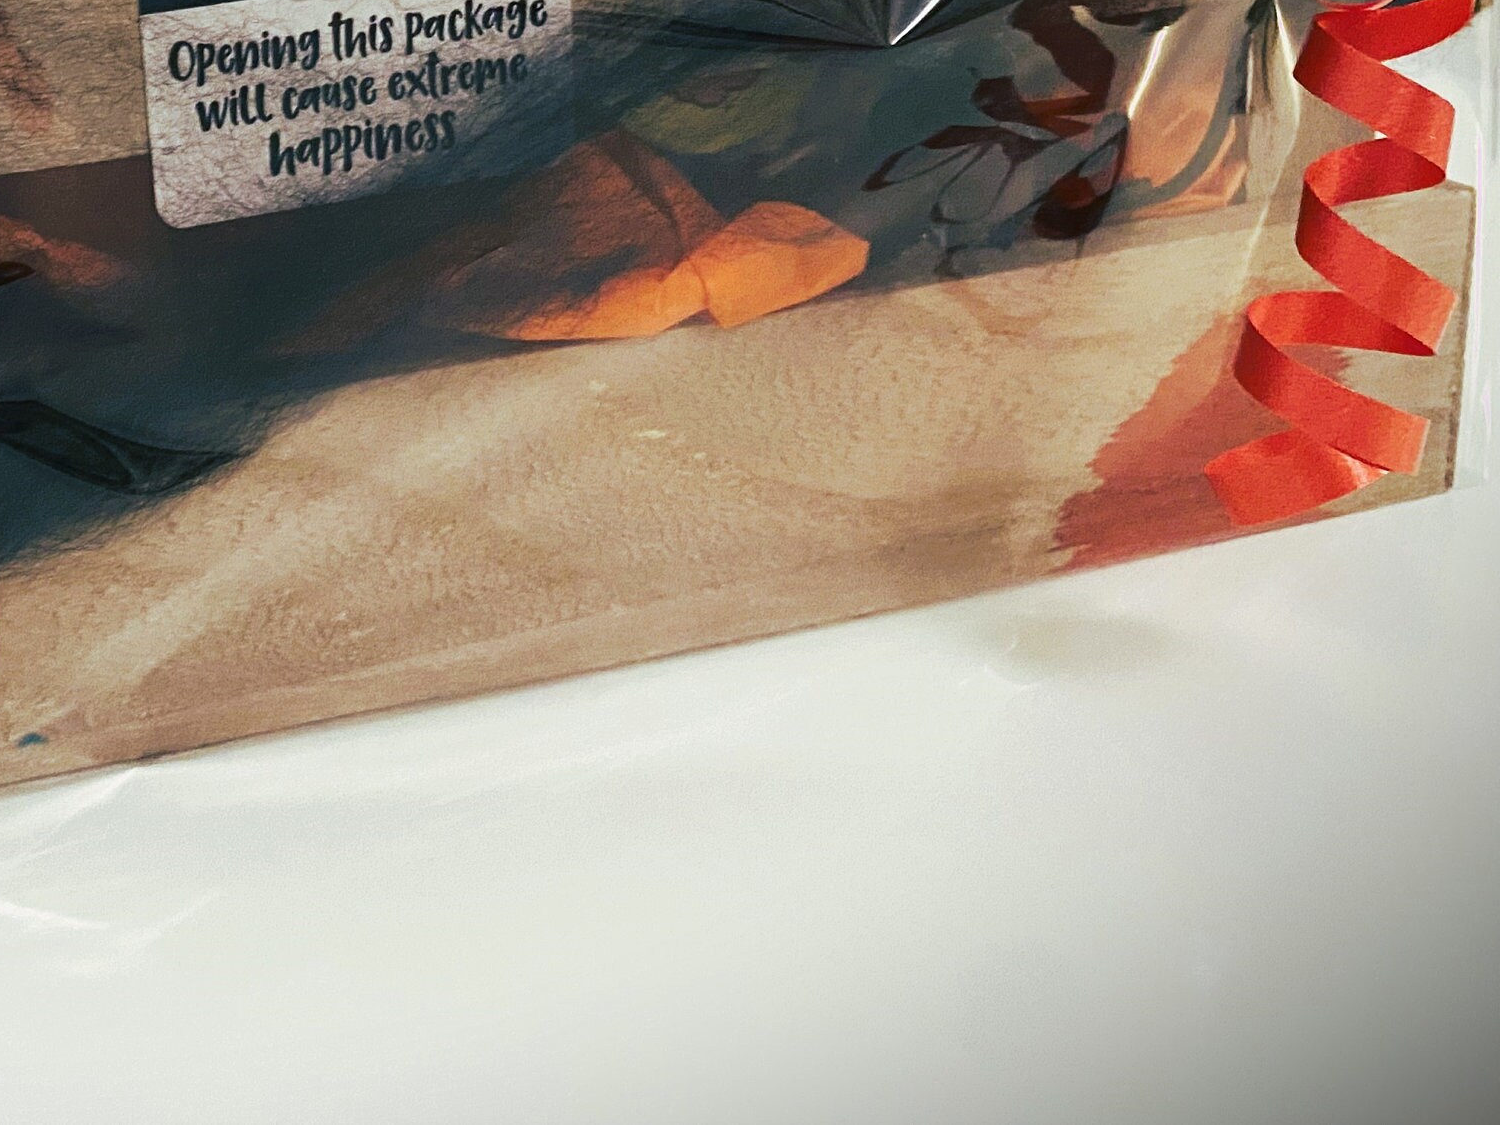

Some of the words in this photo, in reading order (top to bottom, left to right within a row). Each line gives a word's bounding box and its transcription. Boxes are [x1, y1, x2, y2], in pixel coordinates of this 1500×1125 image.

[168, 27, 320, 87] Opening
[328, 11, 394, 63] this
[195, 81, 272, 133] will
[281, 74, 378, 121] cause
[388, 49, 529, 103] extreme
[268, 109, 457, 178] happiness
